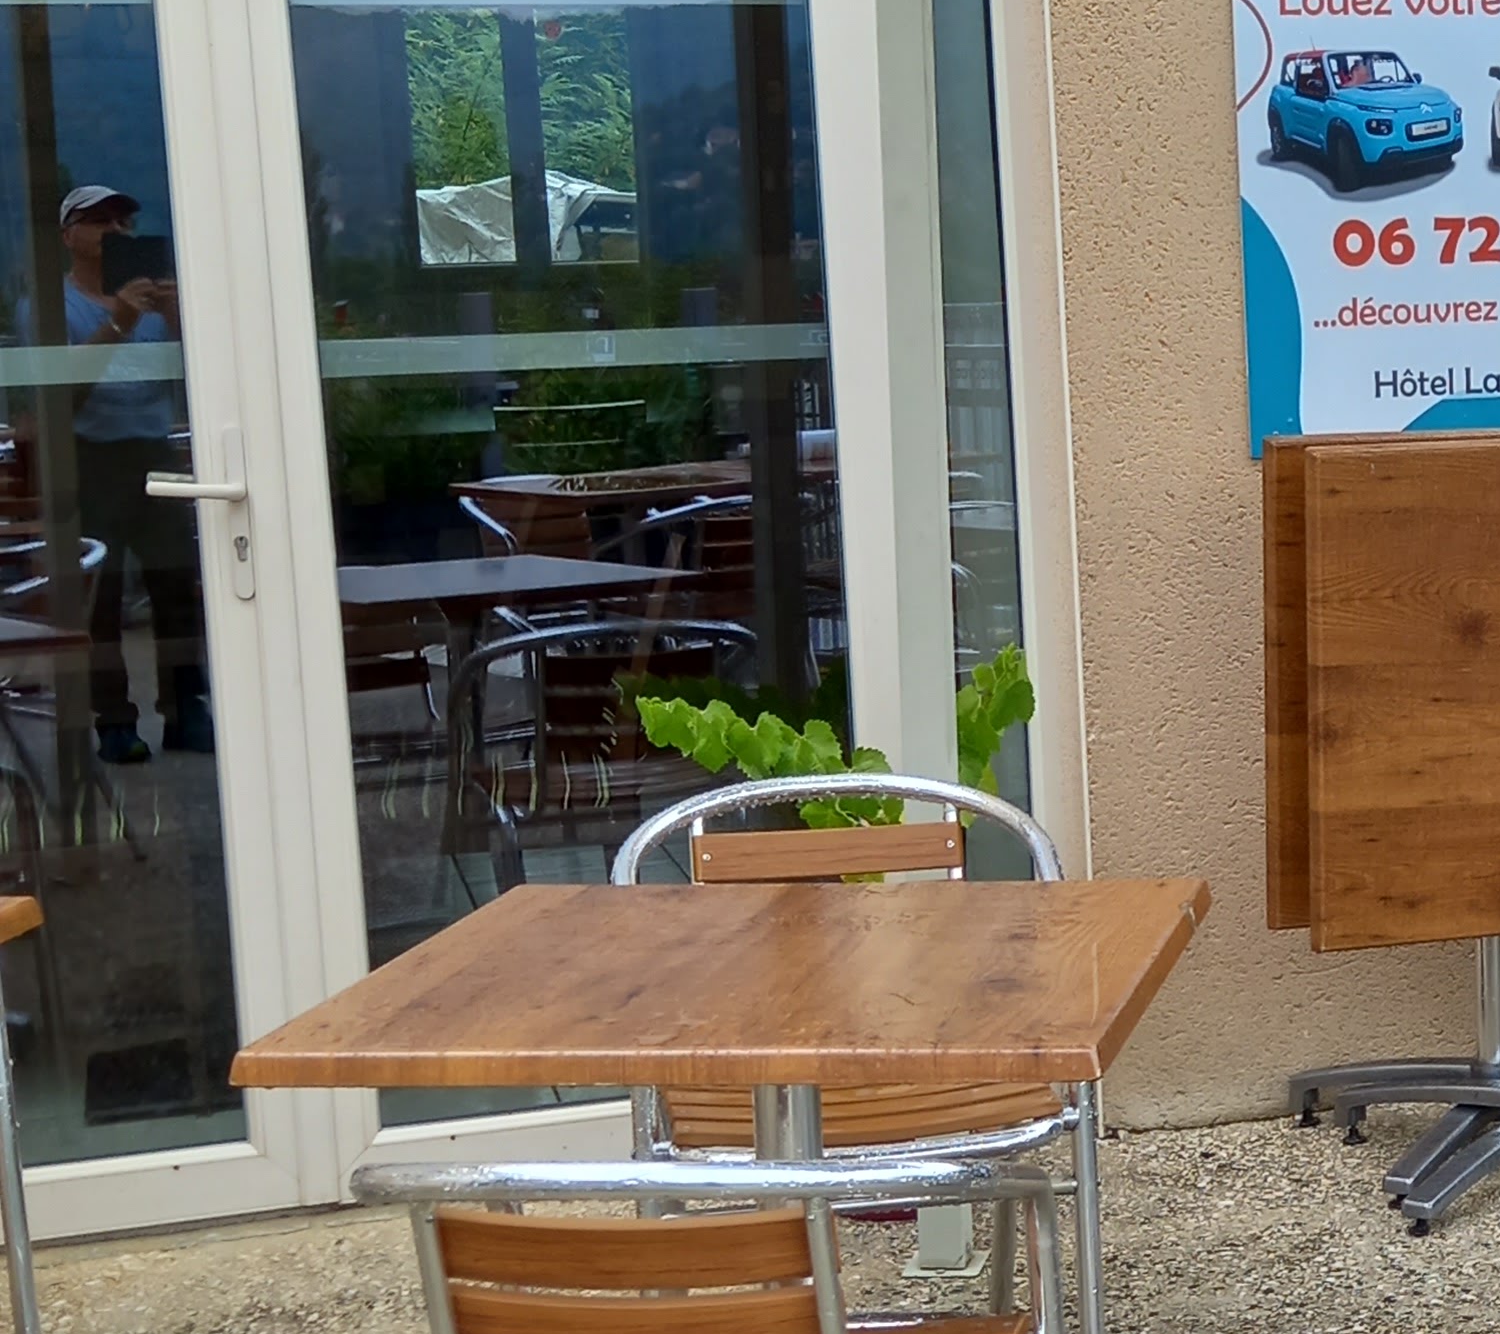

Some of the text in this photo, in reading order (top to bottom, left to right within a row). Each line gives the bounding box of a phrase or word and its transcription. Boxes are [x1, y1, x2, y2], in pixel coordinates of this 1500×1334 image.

[1333, 217, 1416, 267] 06
[1313, 297, 1498, 328] ...découvrez
[1374, 366, 1454, 398] Hôtel
